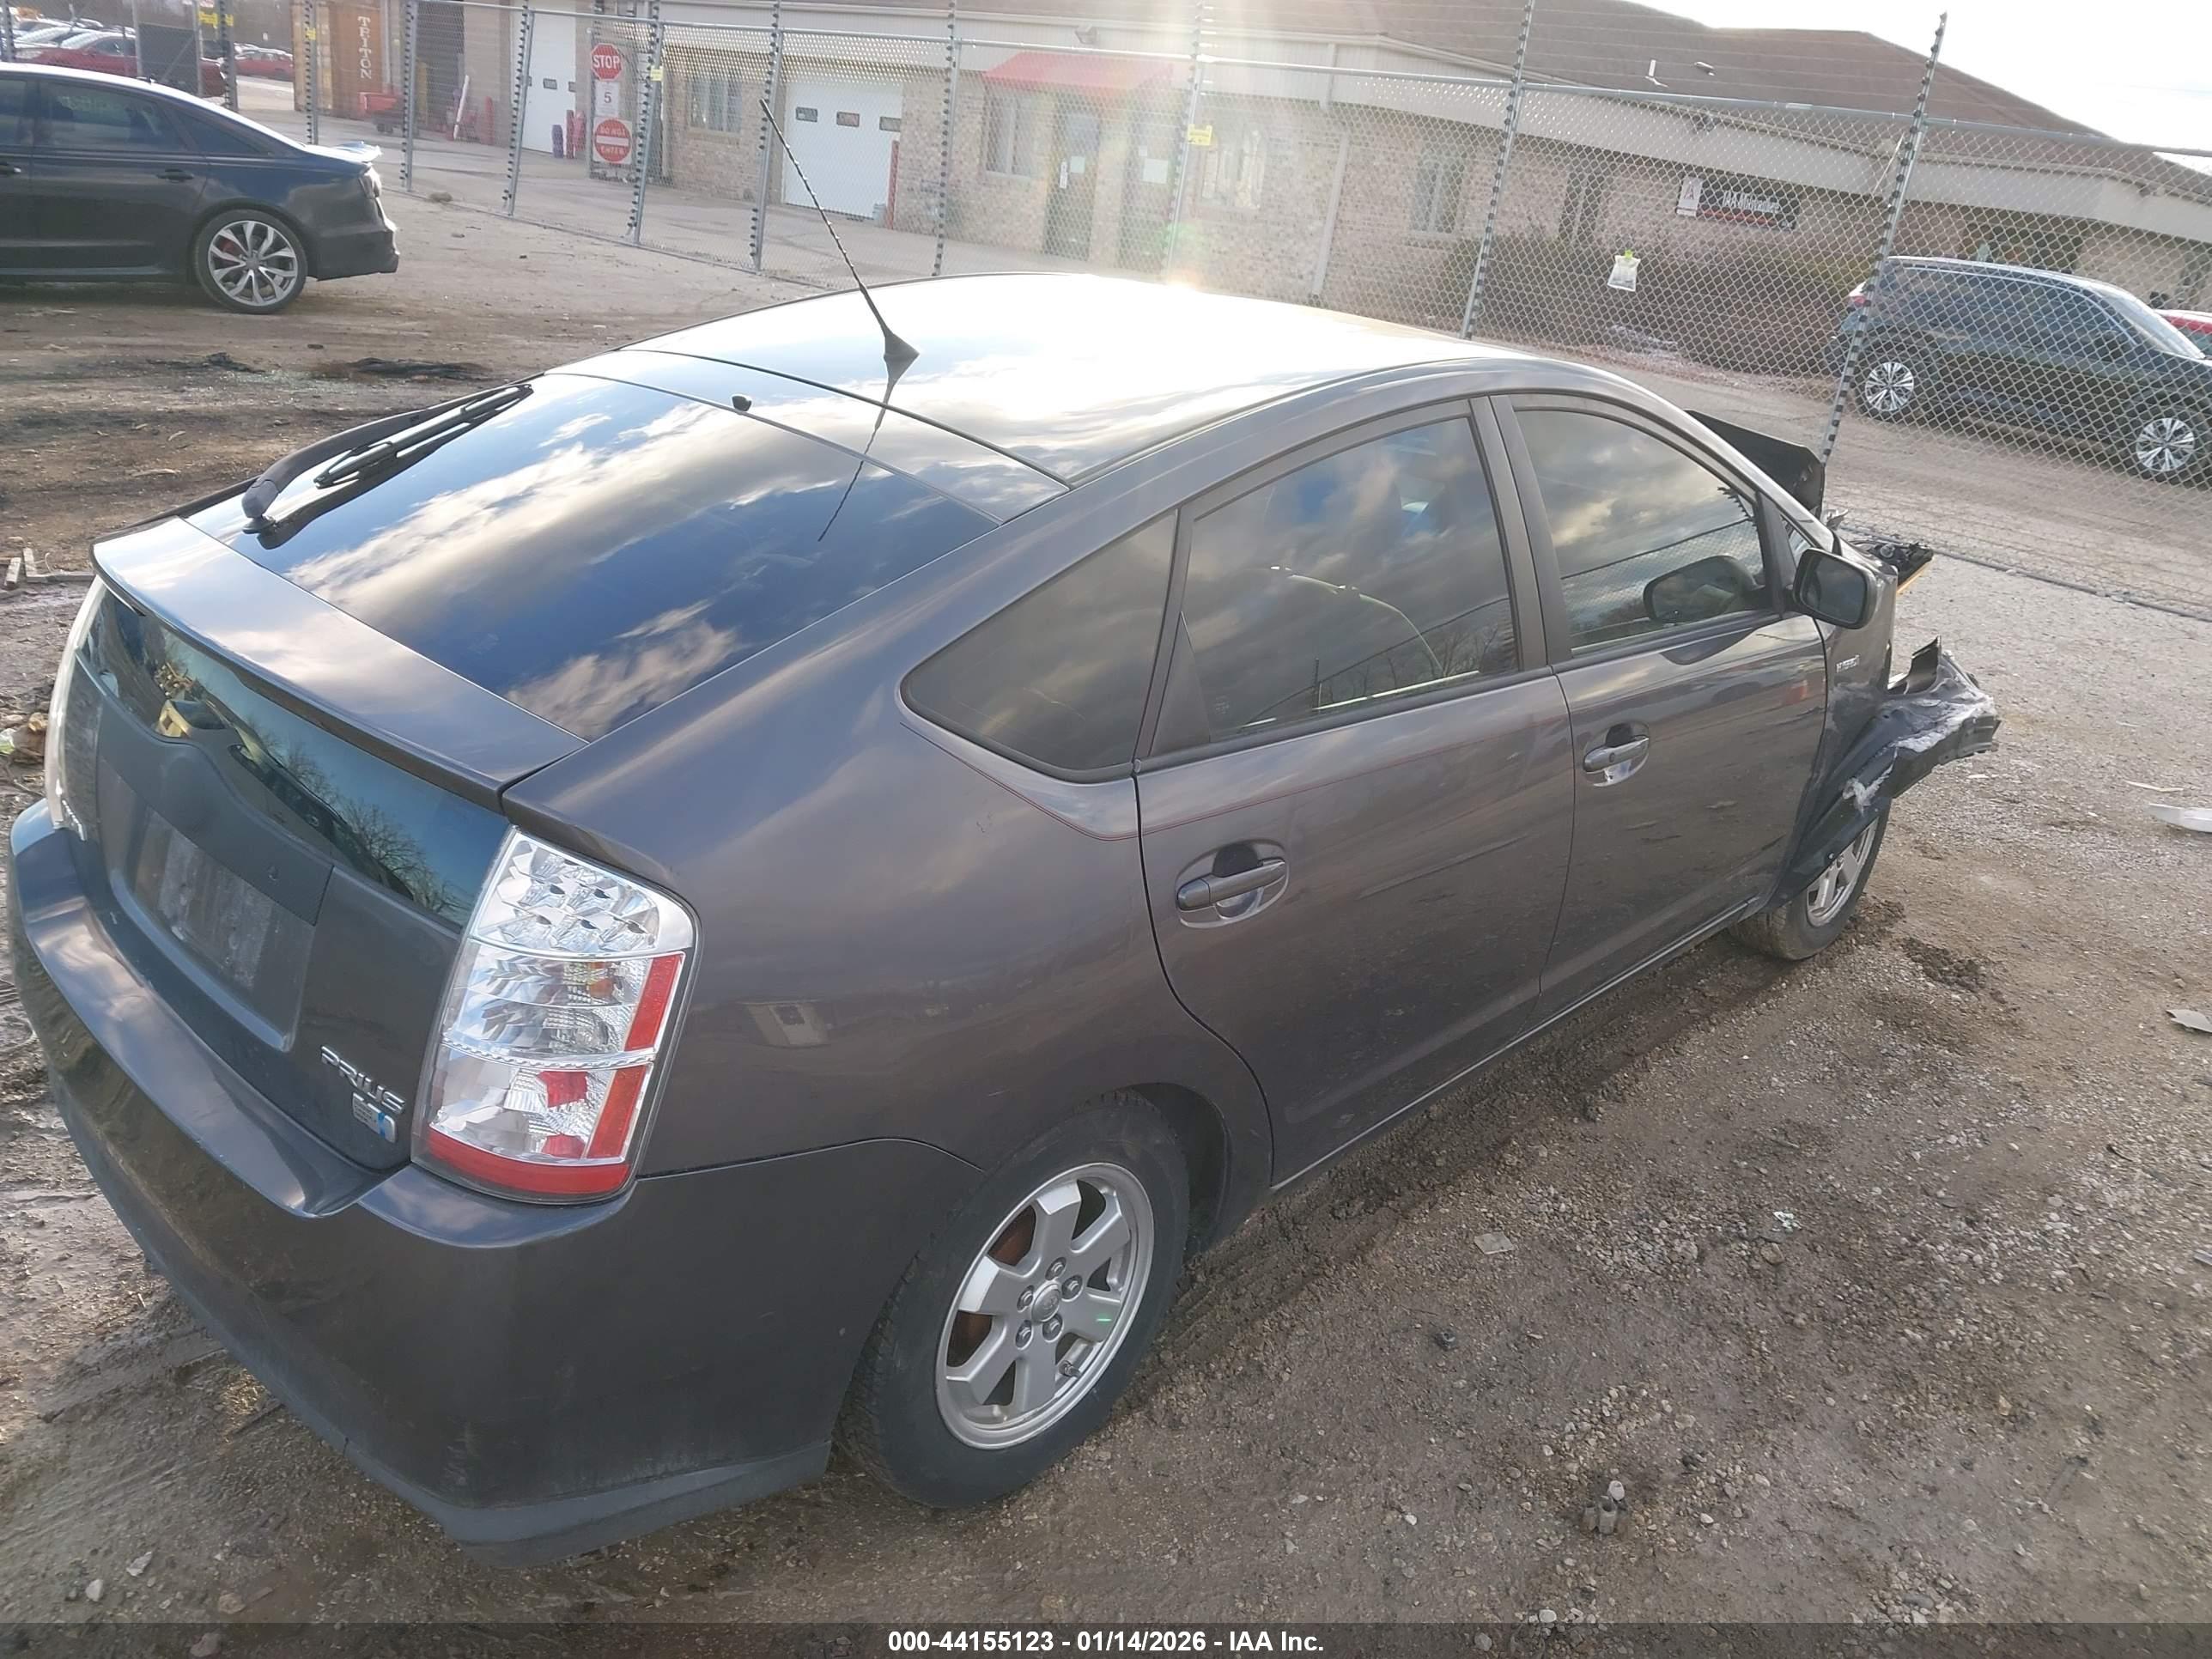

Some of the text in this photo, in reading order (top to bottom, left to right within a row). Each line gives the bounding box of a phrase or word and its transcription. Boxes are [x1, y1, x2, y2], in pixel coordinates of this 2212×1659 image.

[357, 15, 372, 79] TRITON
[592, 55, 620, 70] STOP
[604, 91, 612, 104] 5
[321, 1046, 405, 1115] PRIUS
